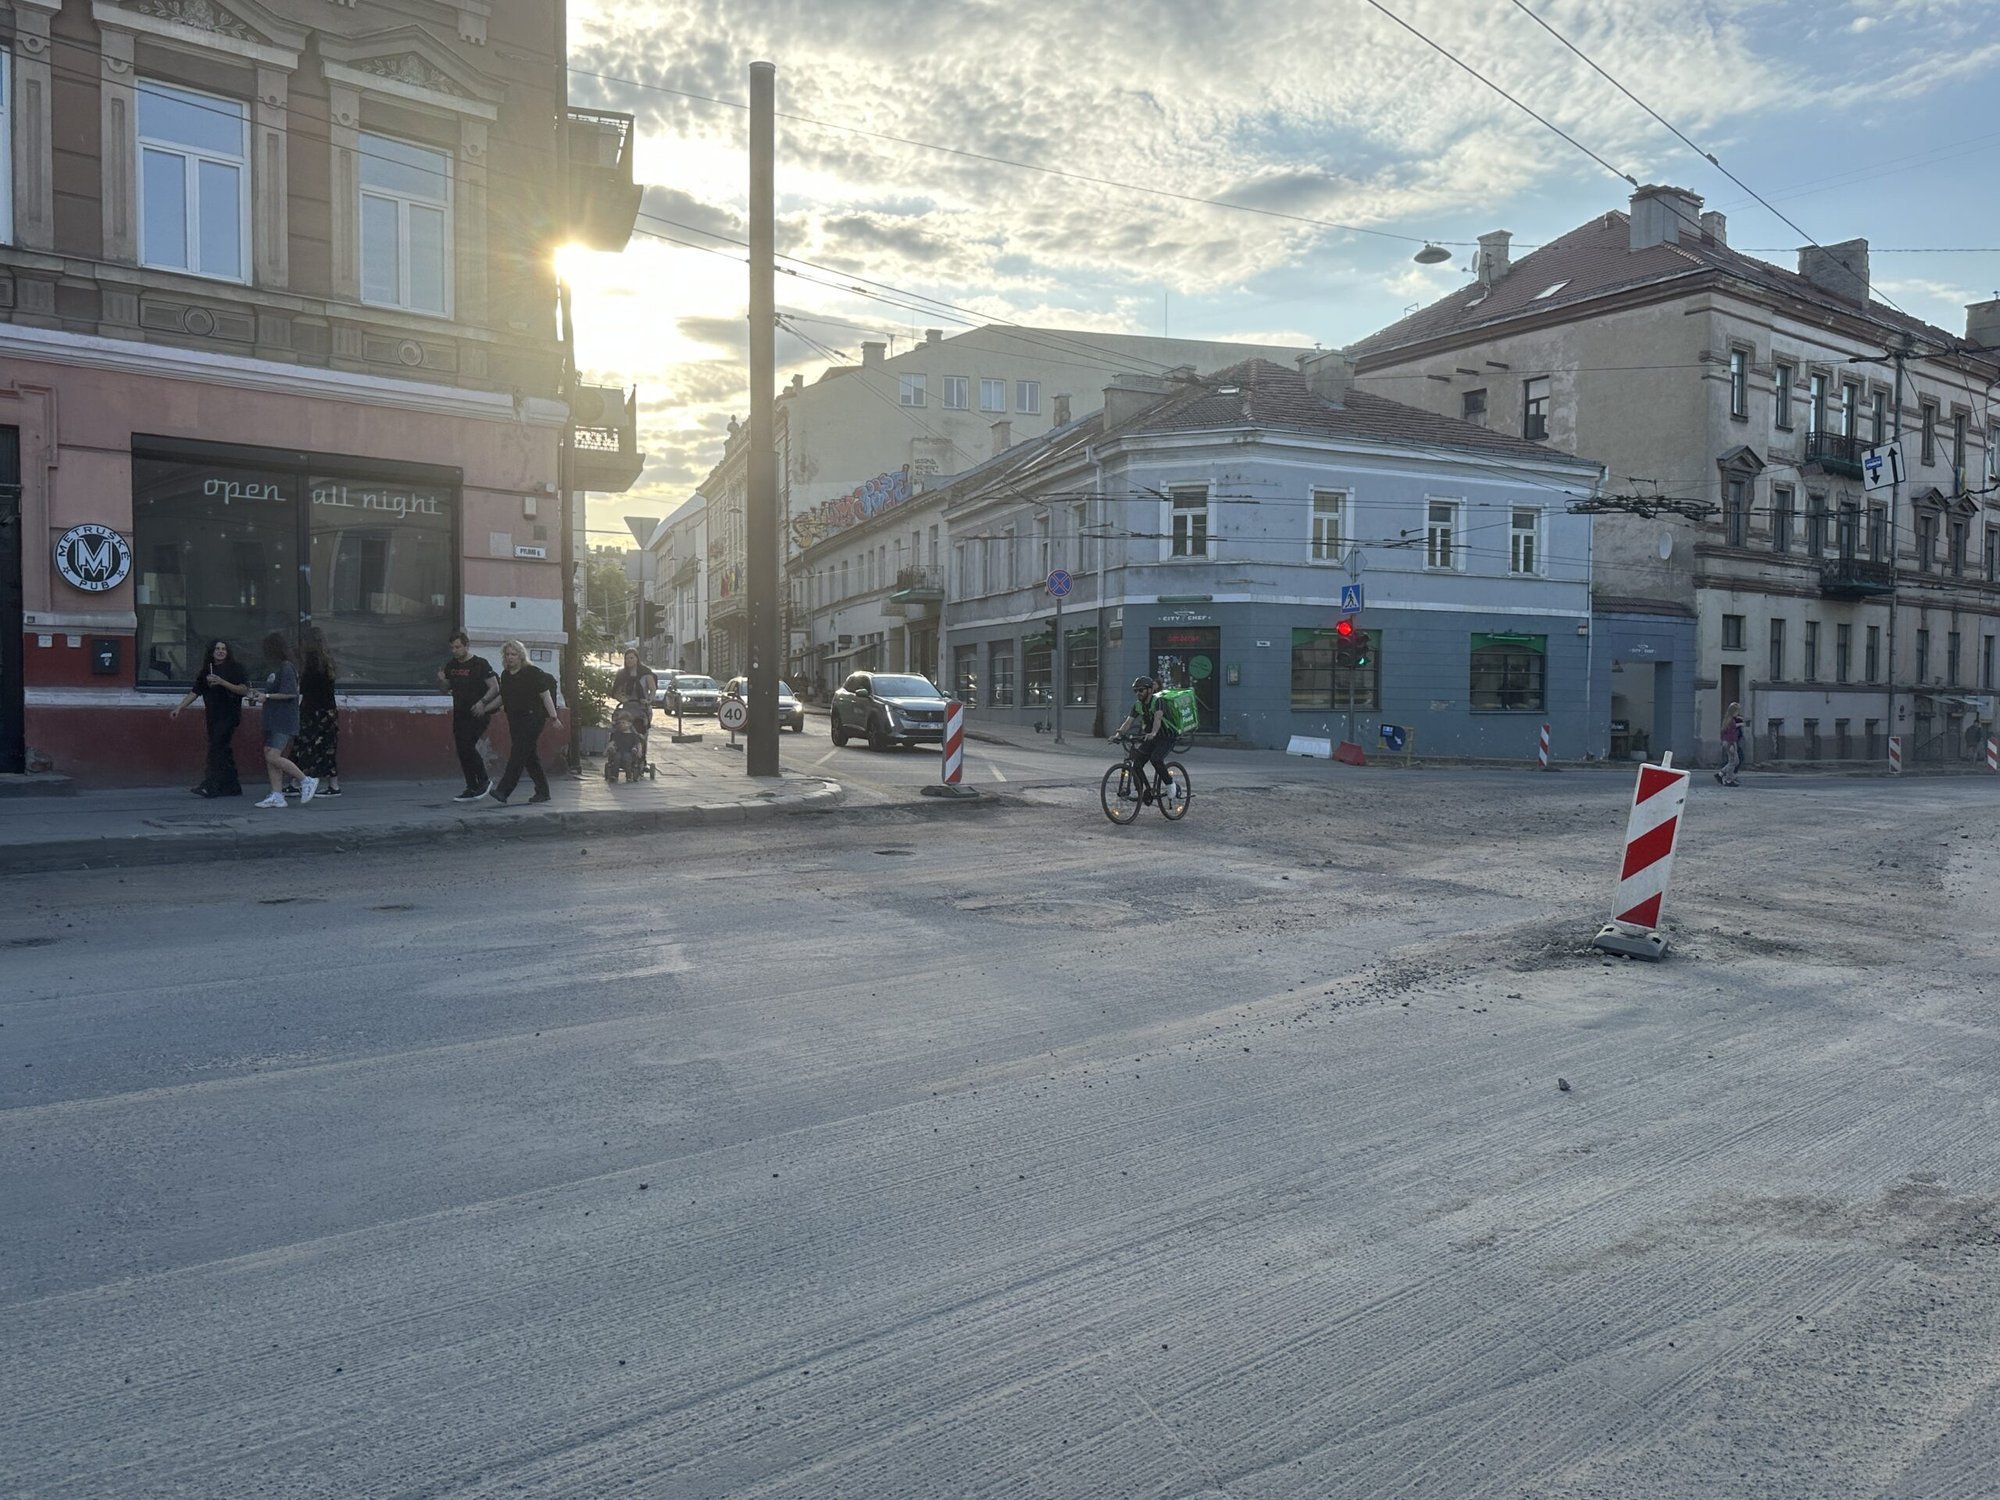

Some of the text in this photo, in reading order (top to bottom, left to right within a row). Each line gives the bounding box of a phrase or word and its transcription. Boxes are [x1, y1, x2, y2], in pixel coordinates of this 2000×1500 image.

[204, 478, 443, 519] open all night
[79, 581, 110, 590] PUB
[724, 708, 743, 721] 40
